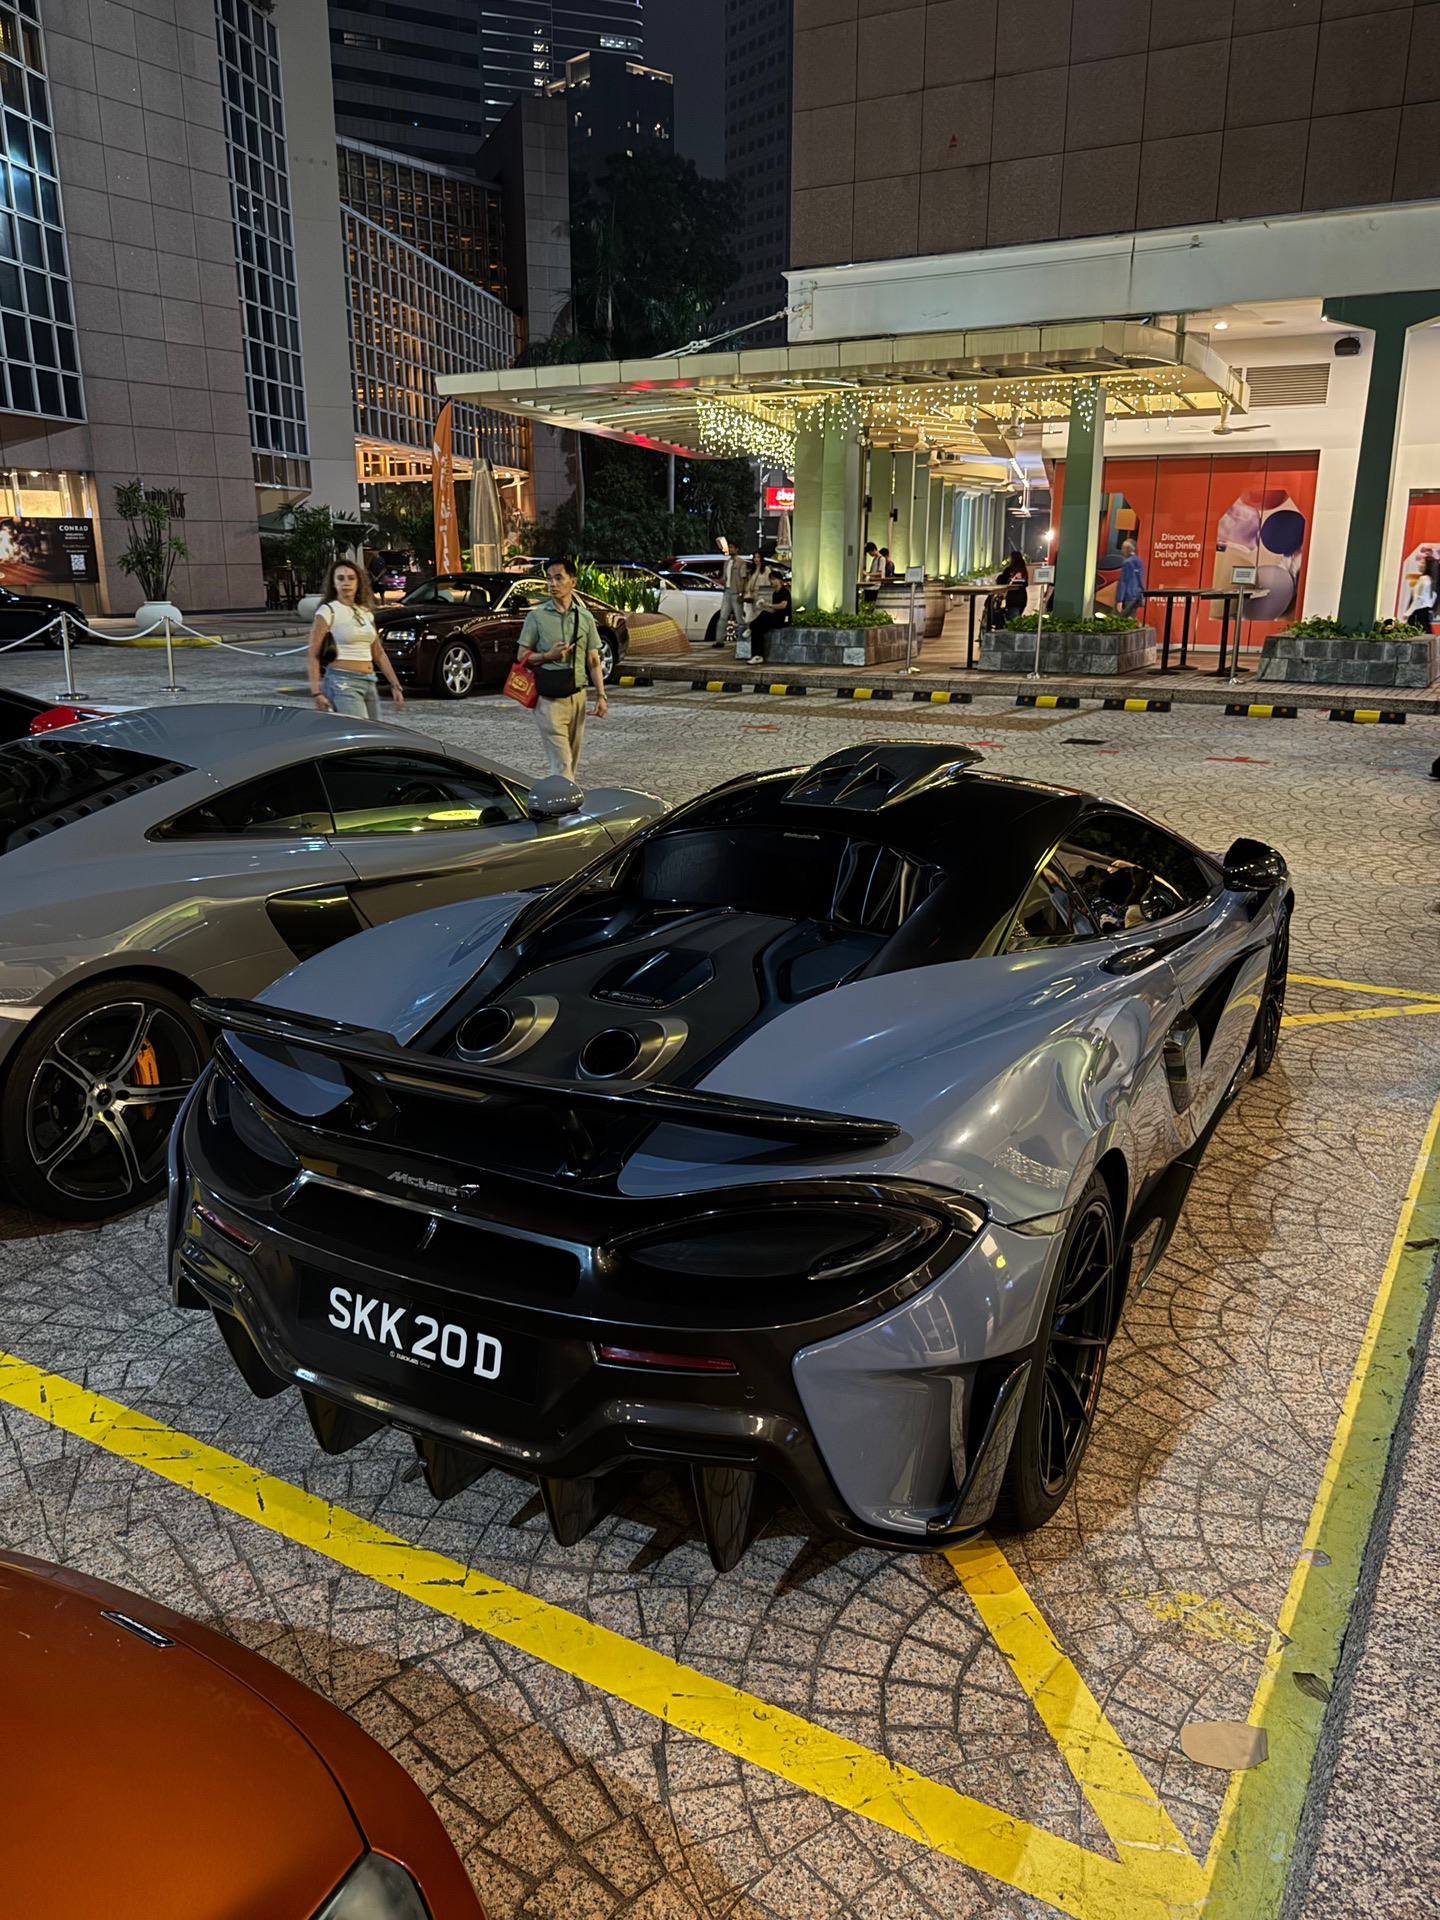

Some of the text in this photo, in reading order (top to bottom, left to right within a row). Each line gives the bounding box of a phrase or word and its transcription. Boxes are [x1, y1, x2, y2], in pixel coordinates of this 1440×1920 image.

[1161, 533, 1195, 541] Discover
[1154, 542, 1201, 552] More Dining
[1154, 551, 1187, 560] Delights
[1161, 559, 1190, 567] Level 2.
[328, 1286, 503, 1380] SKK 20 D
